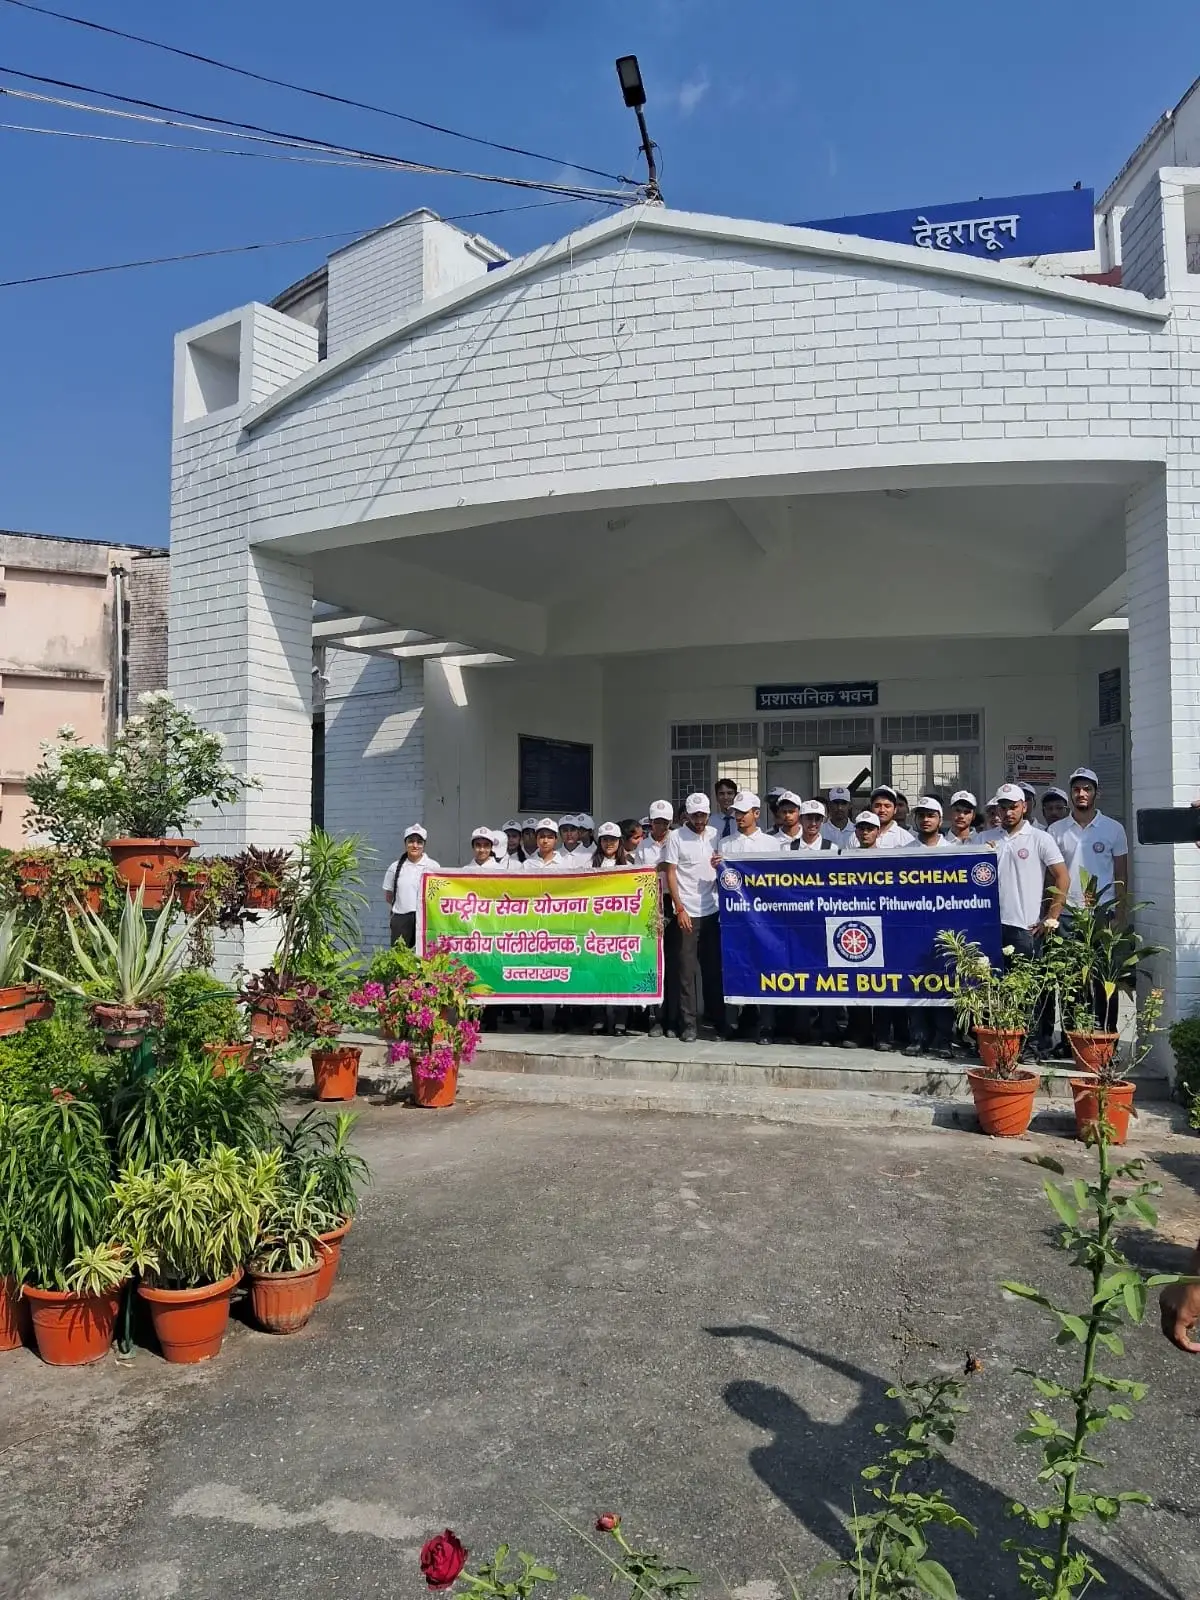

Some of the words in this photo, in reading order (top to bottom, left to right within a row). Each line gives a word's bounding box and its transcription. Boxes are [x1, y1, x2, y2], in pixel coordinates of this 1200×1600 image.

[912, 215, 1020, 250] देहरादून
[760, 688, 834, 706] प्रशासनिक
[839, 689, 873, 703] भवन
[745, 874, 824, 887] NATIONAL
[829, 871, 894, 885] SERVICE
[899, 869, 967, 884] SCHEME
[440, 893, 490, 920] राष्ट्रीय
[496, 895, 528, 914] सेवा
[534, 894, 587, 913] योजना
[593, 889, 641, 913] इकाई
[726, 897, 750, 911] Unit:
[754, 897, 814, 911] Government
[817, 896, 876, 914] Polytechnic
[585, 932, 640, 961] देहरादून
[503, 967, 570, 982] उत्तराखण्ड
[761, 973, 809, 991] NOT
[816, 974, 848, 991] ME
[857, 974, 902, 992] BUT
[908, 974, 960, 992] YOU
